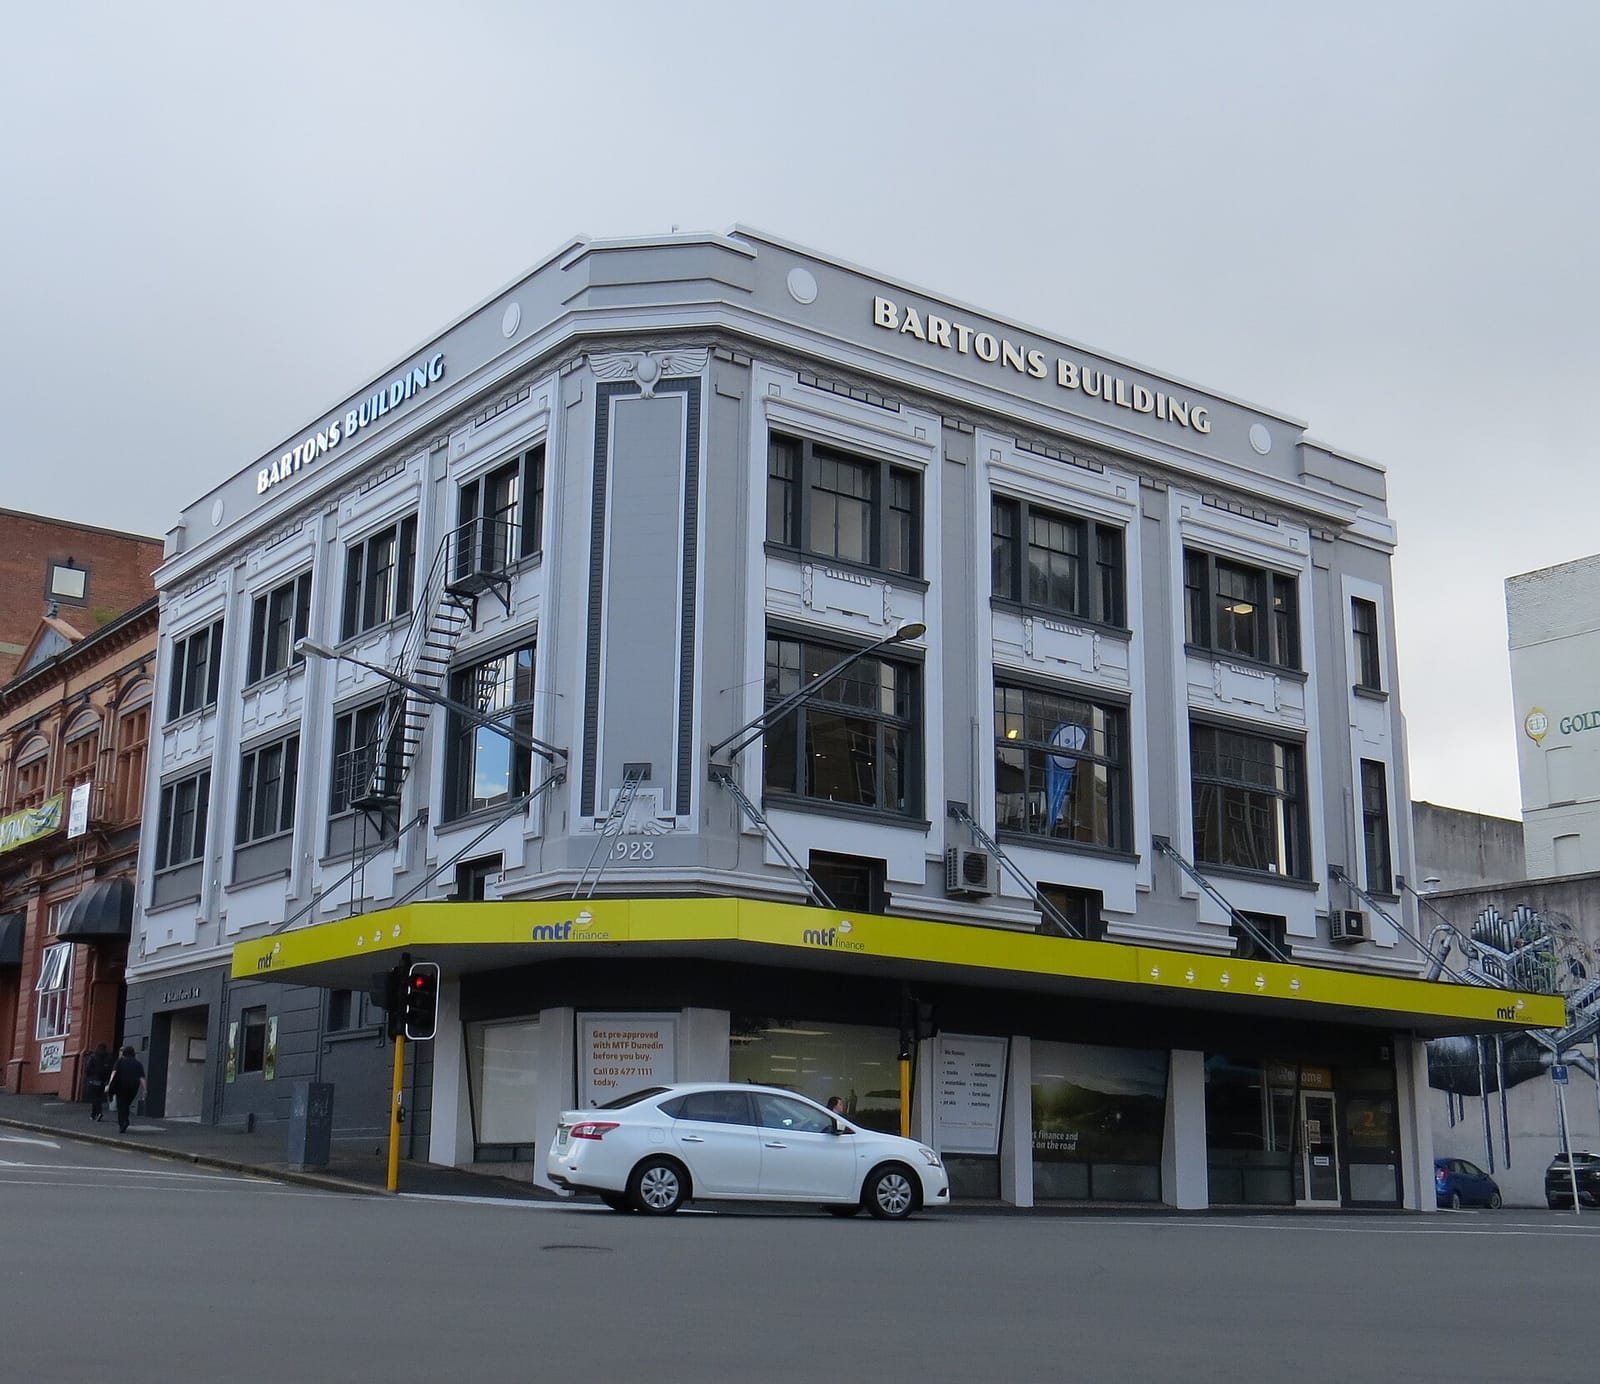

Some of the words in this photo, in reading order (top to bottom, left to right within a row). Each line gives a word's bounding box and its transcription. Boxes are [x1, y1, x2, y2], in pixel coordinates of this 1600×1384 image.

[873, 296, 1048, 378] BARTONS
[1057, 358, 1211, 433] BUILDING
[257, 420, 341, 494] BARTONS
[344, 353, 445, 438] BUILDING
[609, 841, 655, 860] 1928
[532, 920, 573, 941] mtf
[572, 930, 609, 940] finance
[803, 927, 836, 946] mtf
[835, 938, 865, 951] finance
[257, 951, 273, 969] mtf
[1497, 1006, 1516, 1020] mtf
[592, 1030, 606, 1039] Get
[592, 1041, 611, 1049] with
[612, 1041, 630, 1049] MTF
[631, 1041, 664, 1049] Dunedin
[592, 1052, 618, 1060] before
[620, 1053, 634, 1061] you
[635, 1052, 652, 1061] buy.
[593, 1067, 608, 1075] Call
[609, 1067, 619, 1075] 03
[620, 1067, 636, 1075] 477
[638, 1067, 653, 1075] 1111
[593, 1078, 618, 1087] today.
[1038, 1130, 1064, 1140] finance
[1065, 1131, 1079, 1141] and
[1047, 1140, 1059, 1149] the
[1060, 1141, 1076, 1151] road
